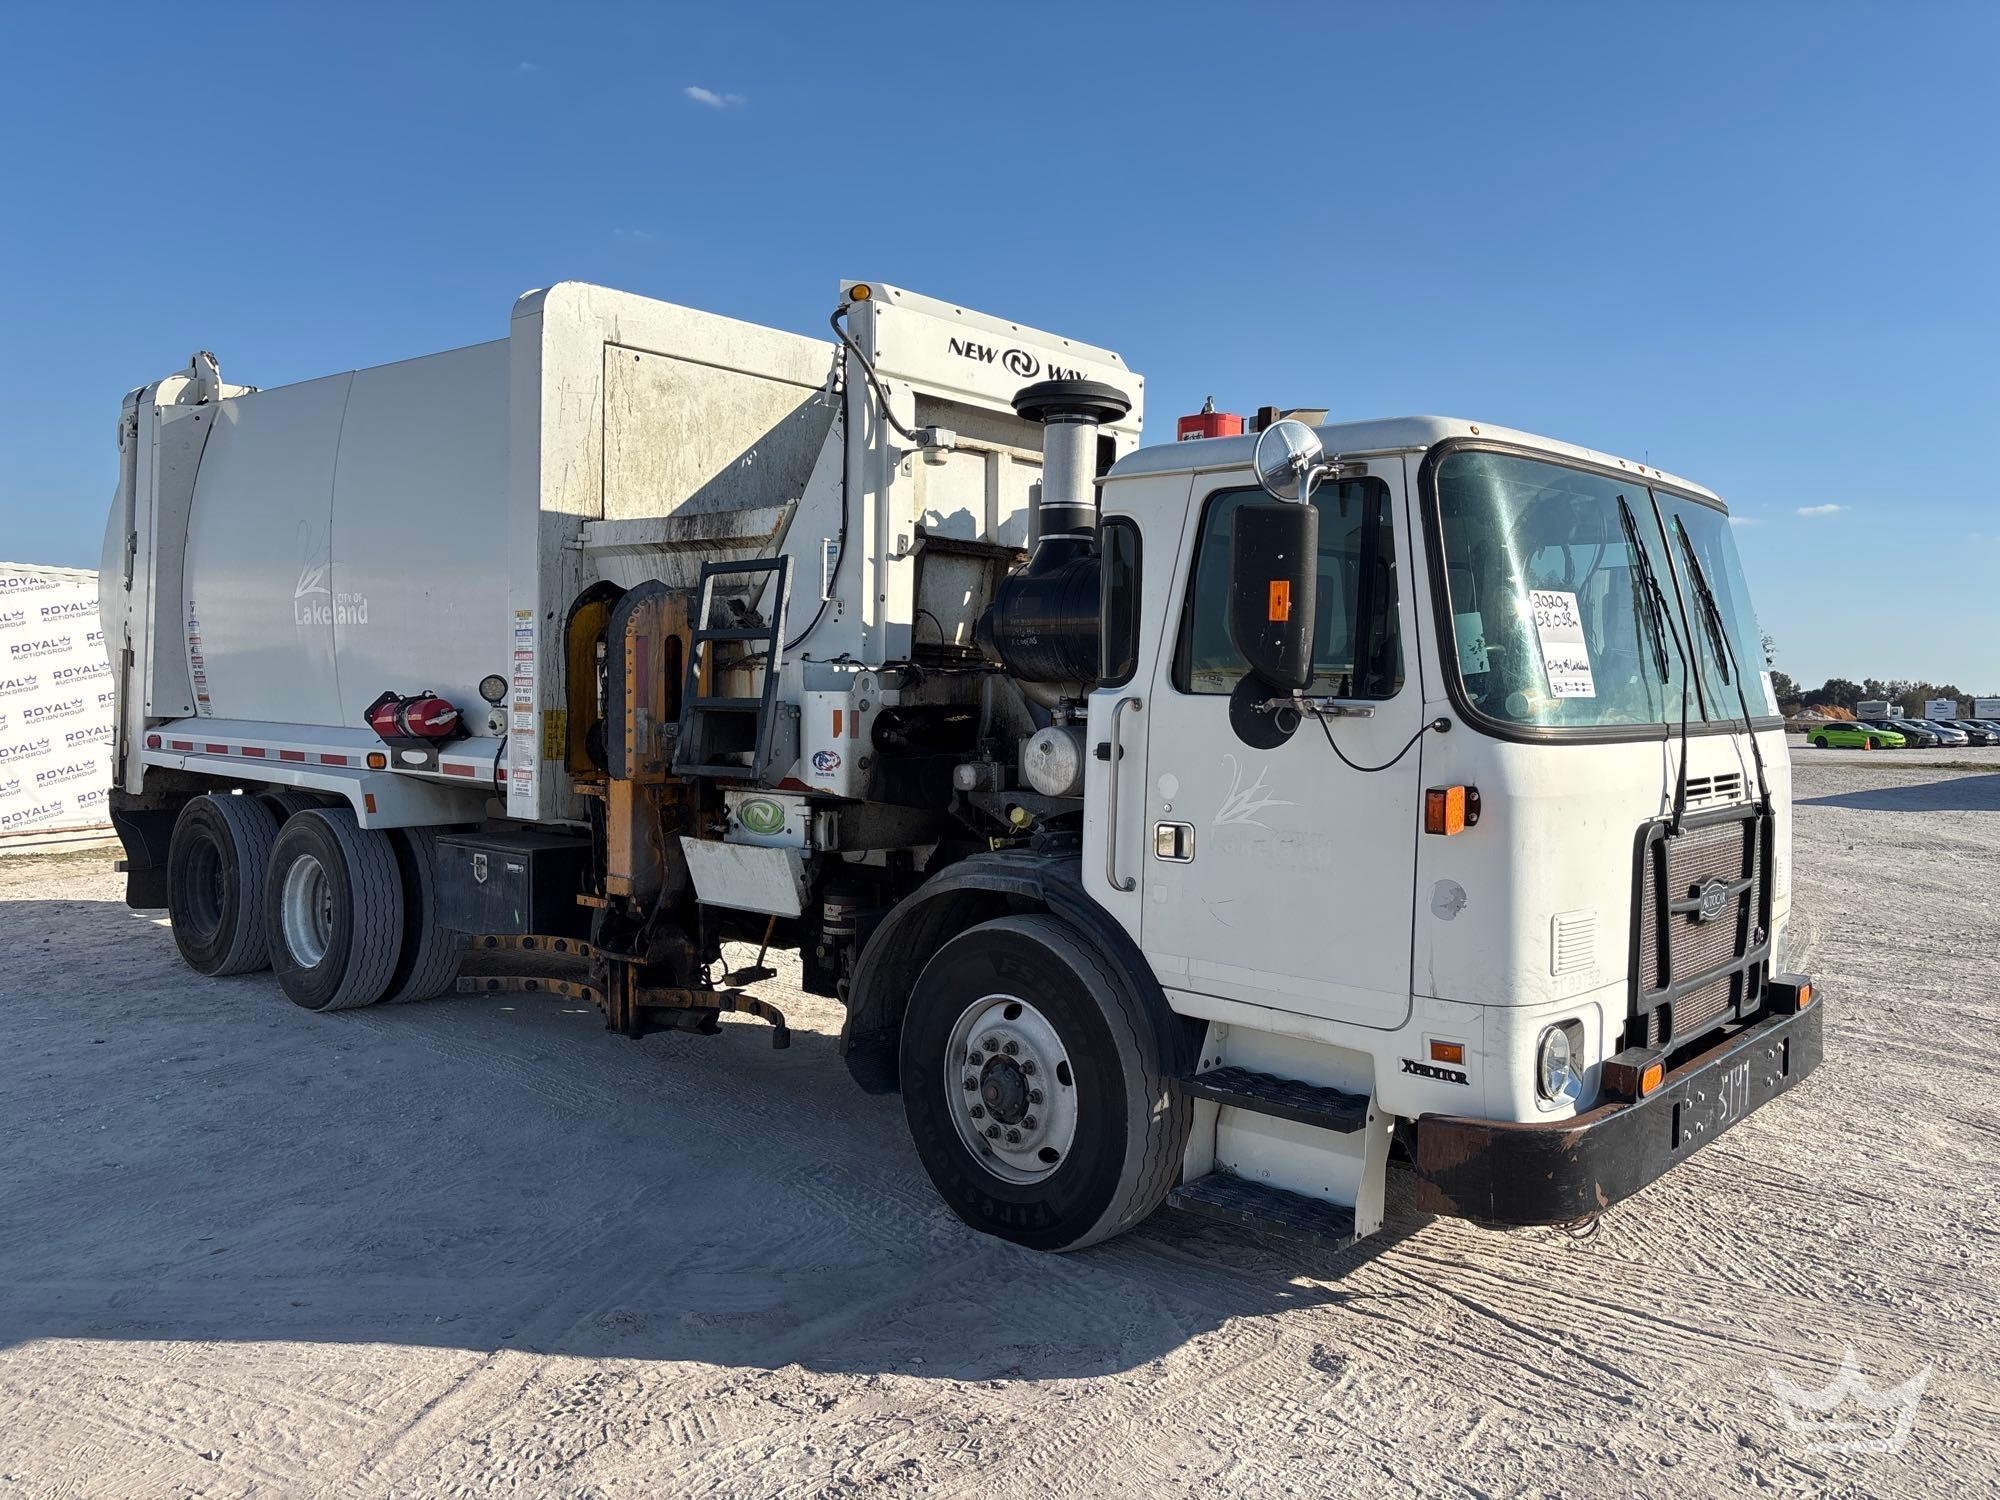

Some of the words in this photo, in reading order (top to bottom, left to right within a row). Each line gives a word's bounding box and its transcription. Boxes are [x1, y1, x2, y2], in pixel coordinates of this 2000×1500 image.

[948, 337, 998, 364] NEW
[35, 583, 60, 591] GROUP
[337, 593, 352, 603] CITY
[353, 592, 363, 602] OF
[40, 602, 87, 616] ROYAL
[295, 598, 368, 625] Lakeland
[42, 613, 75, 623] AUCTION
[10, 639, 59, 654] ROYAL
[12, 650, 46, 661] AUCTION
[47, 645, 73, 655] GROUP
[53, 664, 99, 680] ROYAL
[55, 675, 87, 686] AUCTION
[12, 685, 39, 695] GROUP
[23, 702, 71, 718] ROYAL
[25, 714, 59, 725] AUCTION
[59, 707, 85, 718] GROUP
[65, 725, 111, 742] ROYAL
[0, 742, 37, 757] OYAL
[67, 736, 99, 748] AUCTION
[25, 748, 52, 759] GROUP
[36, 764, 83, 782] ROYAL
[38, 776, 71, 788] AUCTION
[71, 769, 97, 779] GROUP
[1, 805, 50, 825] ROYAL
[3, 819, 38, 831] AUCTION
[39, 810, 65, 821] GROUP
[1702, 891, 1727, 909] AUTOCAR
[1401, 1058, 1470, 1086] XPEDITOR
